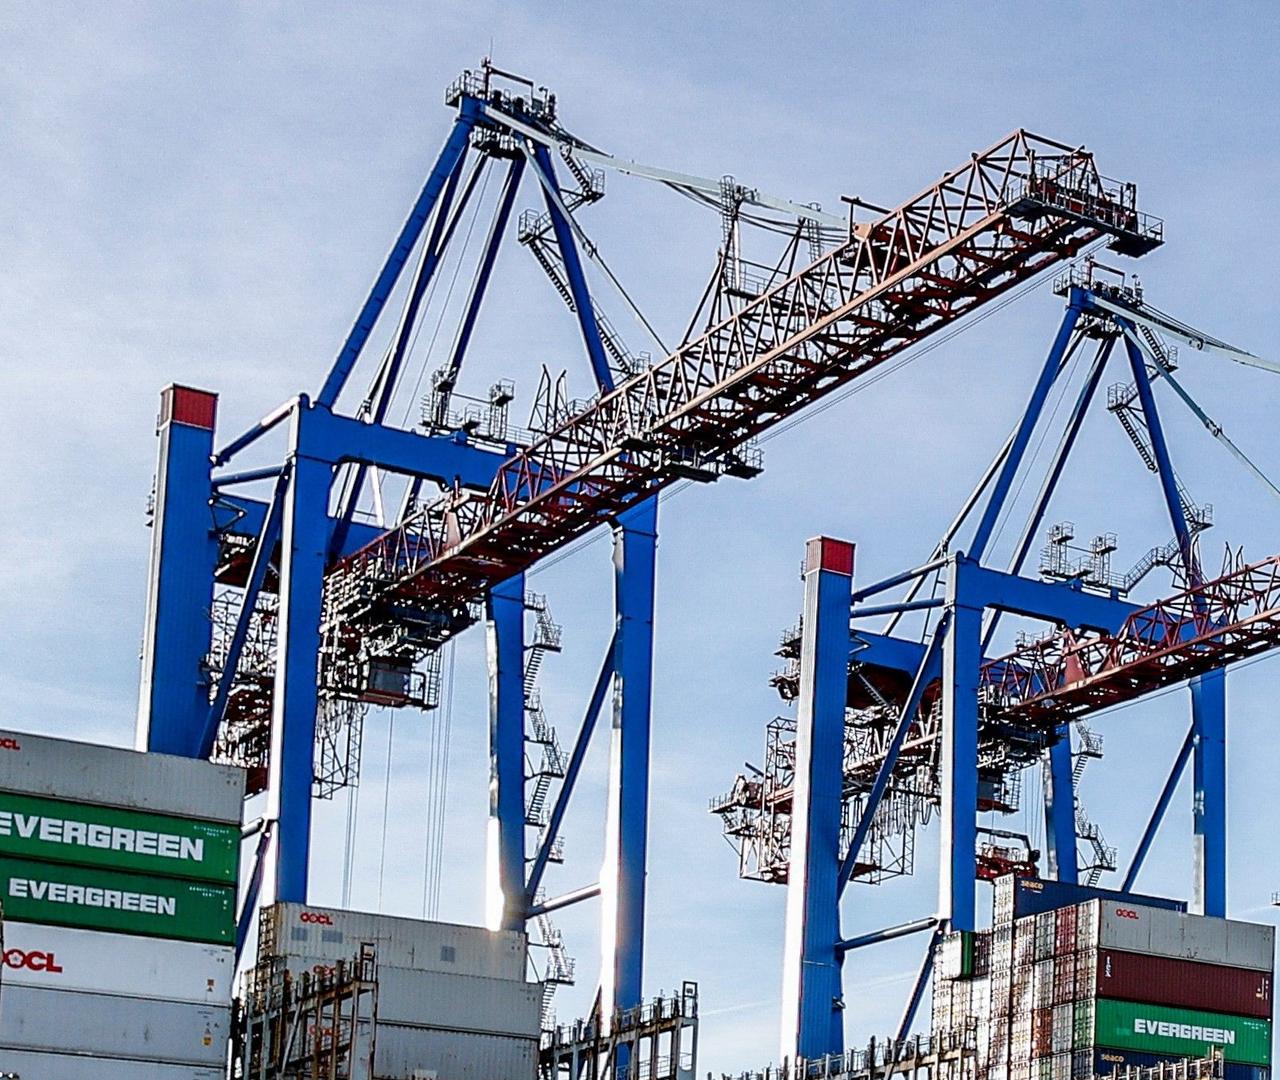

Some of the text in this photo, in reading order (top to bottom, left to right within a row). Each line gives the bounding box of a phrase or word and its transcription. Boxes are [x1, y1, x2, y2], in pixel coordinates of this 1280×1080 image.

[9, 878, 176, 916] EVERGREEN
[300, 912, 333, 925] OOCL
[1115, 908, 1139, 920] OOCL
[2, 948, 63, 973] OCL
[1134, 1018, 1236, 1045] EVERGREEN
